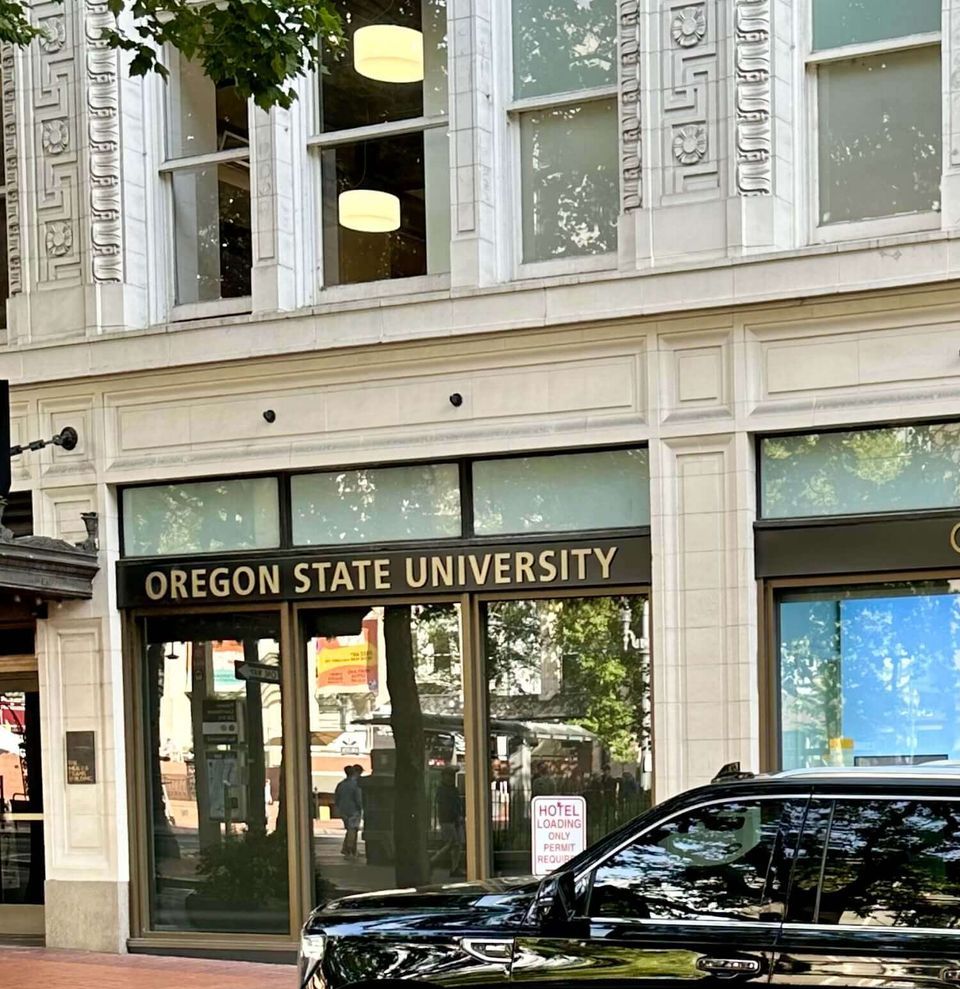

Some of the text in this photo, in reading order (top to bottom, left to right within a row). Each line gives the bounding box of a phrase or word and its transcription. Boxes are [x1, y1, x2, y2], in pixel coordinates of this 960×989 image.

[144, 546, 619, 600] OREGON STATE UNIVERSITY
[539, 804, 580, 817] HOTEL
[537, 818, 582, 829] LOADING
[548, 831, 570, 841] ONLY
[543, 843, 576, 852] PERMIT
[537, 854, 576, 864] REQUIR
